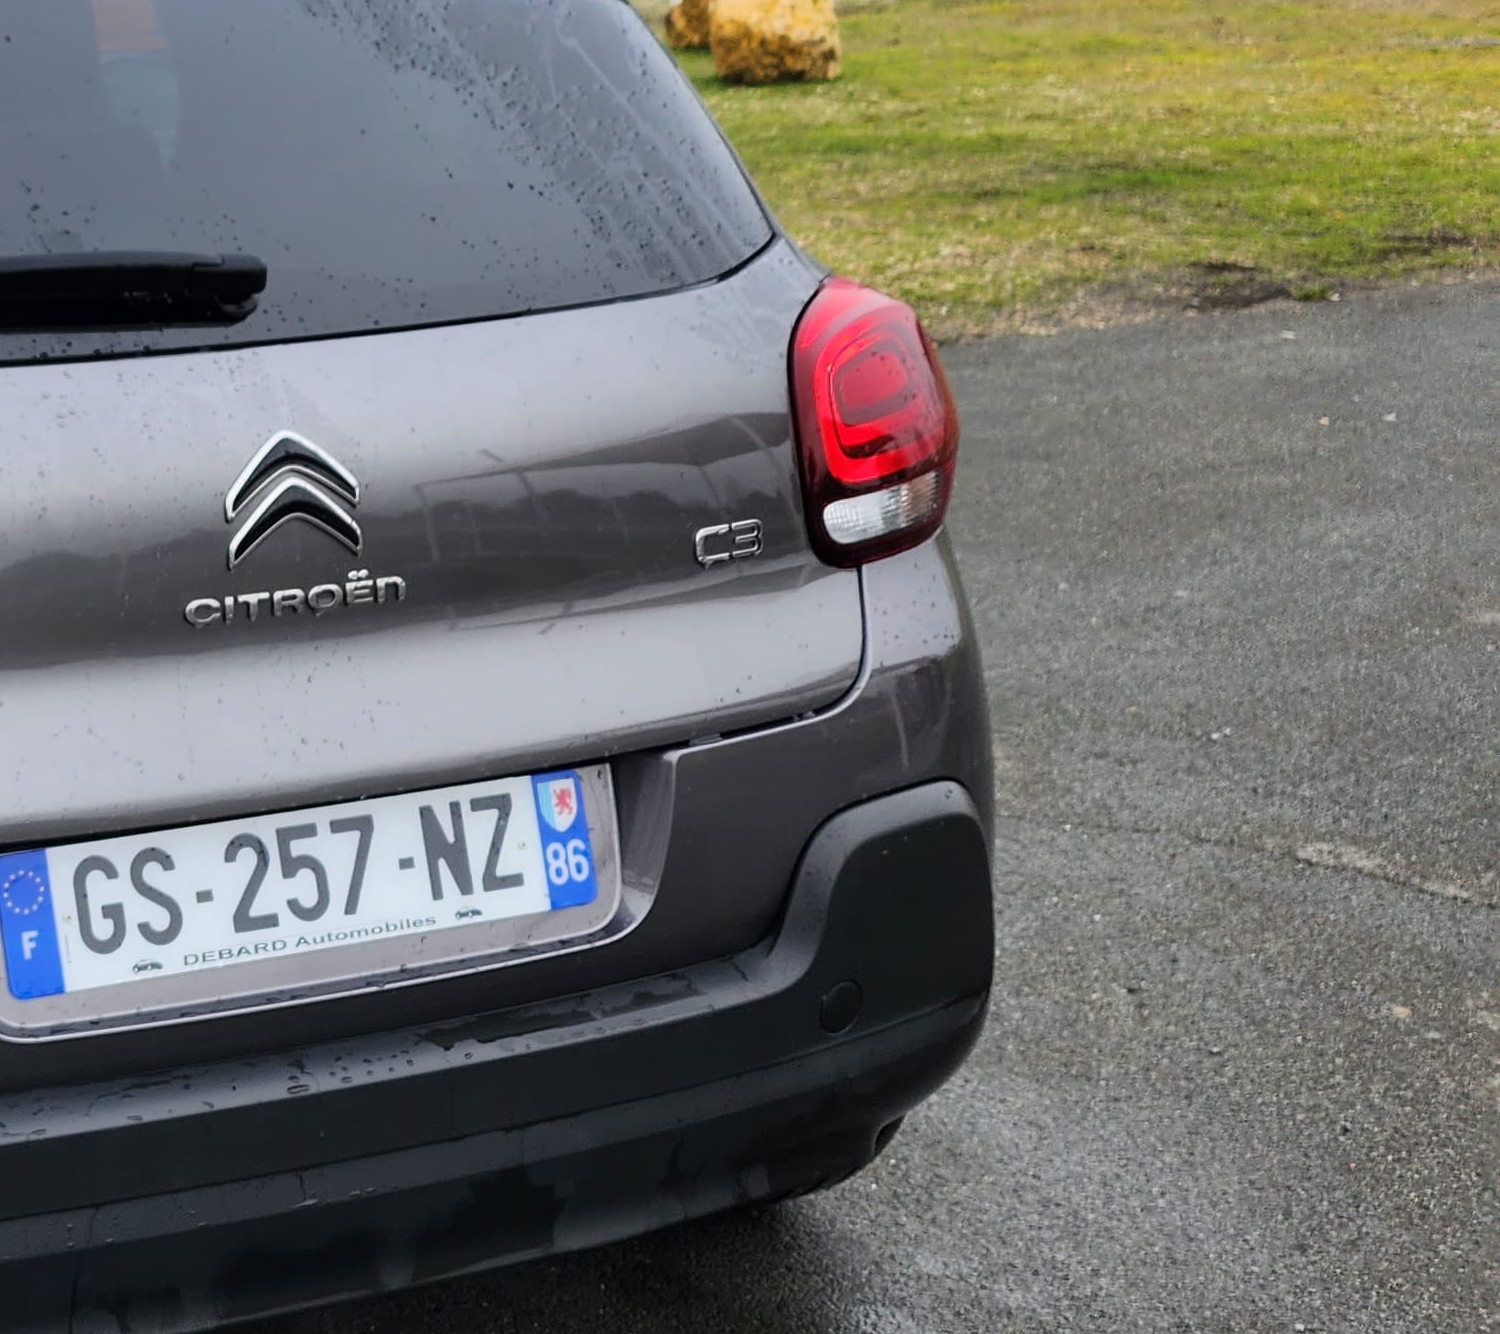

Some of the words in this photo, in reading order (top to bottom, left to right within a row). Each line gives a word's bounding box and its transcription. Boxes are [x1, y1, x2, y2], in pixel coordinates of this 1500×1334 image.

[695, 519, 763, 564] C3
[546, 838, 590, 886] 86
[21, 930, 39, 961] F
[183, 939, 287, 966] DEBARD
[295, 916, 437, 948] Automobiles
